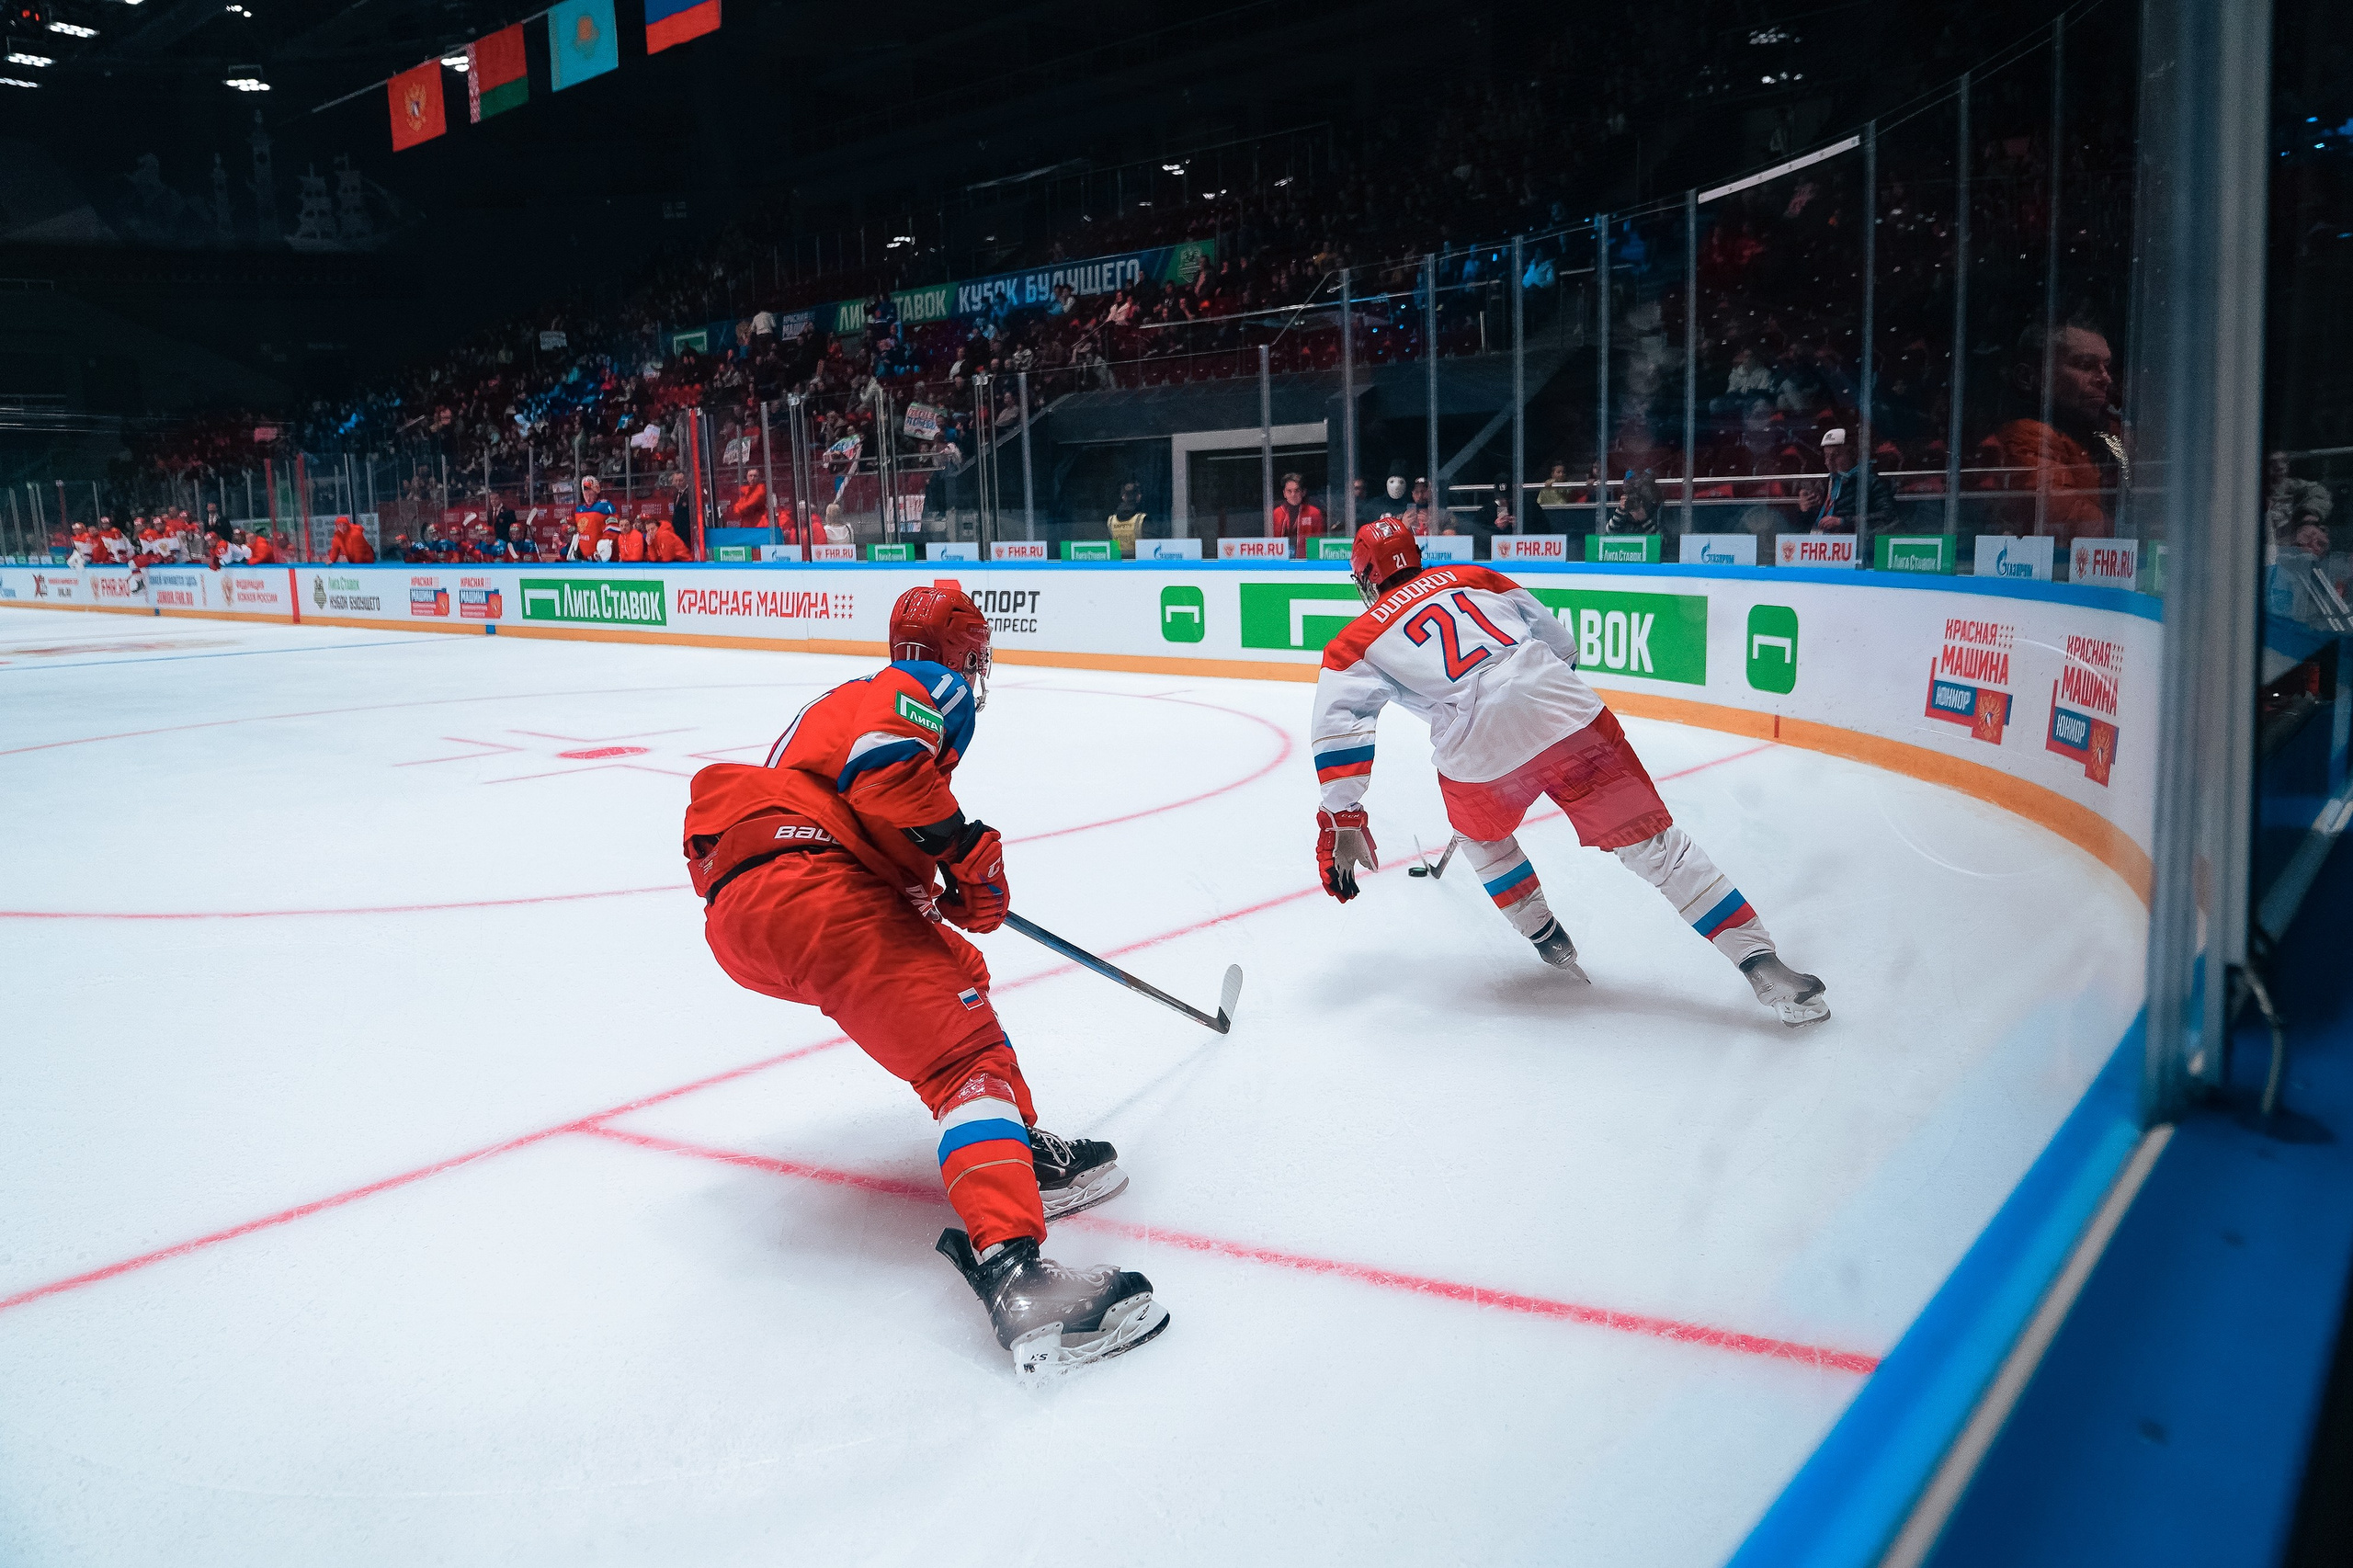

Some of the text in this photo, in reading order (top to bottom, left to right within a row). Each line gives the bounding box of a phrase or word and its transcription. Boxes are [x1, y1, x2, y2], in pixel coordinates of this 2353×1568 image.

[959, 258, 1141, 314] КУБОК БУДУЩЕГО
[893, 290, 948, 322] ТАВОК
[824, 549, 854, 559] FHR.RU
[1007, 546, 1044, 558] FHR.RU
[1240, 543, 1284, 557] FHR.RU
[1392, 552, 1408, 569] 21
[1517, 541, 1563, 557] FHR.RU
[1801, 542, 1853, 562] FHR.RU
[2093, 549, 2134, 579] FHR.RU
[411, 576, 433, 587] КРАСНАЯ
[460, 577, 484, 588] КРАСНАЯ
[563, 583, 663, 621] ЛИГА СТАВОК
[677, 588, 830, 619] КРАСНАЯ МАШИНА
[972, 590, 1040, 614] СПОРТ
[1370, 570, 1459, 624] DUDOROV
[986, 618, 1038, 633] СПРЕСС
[1403, 590, 1520, 683] 21
[1944, 619, 1999, 646] КРАСНАЯ
[2065, 634, 2112, 667] КРАСНАЯ
[1940, 644, 2010, 686] МАШИНА
[930, 673, 968, 717] 11
[1935, 685, 1972, 710] ЮНИОР
[2061, 665, 2119, 716] МАШИНА
[909, 710, 939, 733] ЛИГА
[2055, 713, 2086, 744] ЮНИОР
